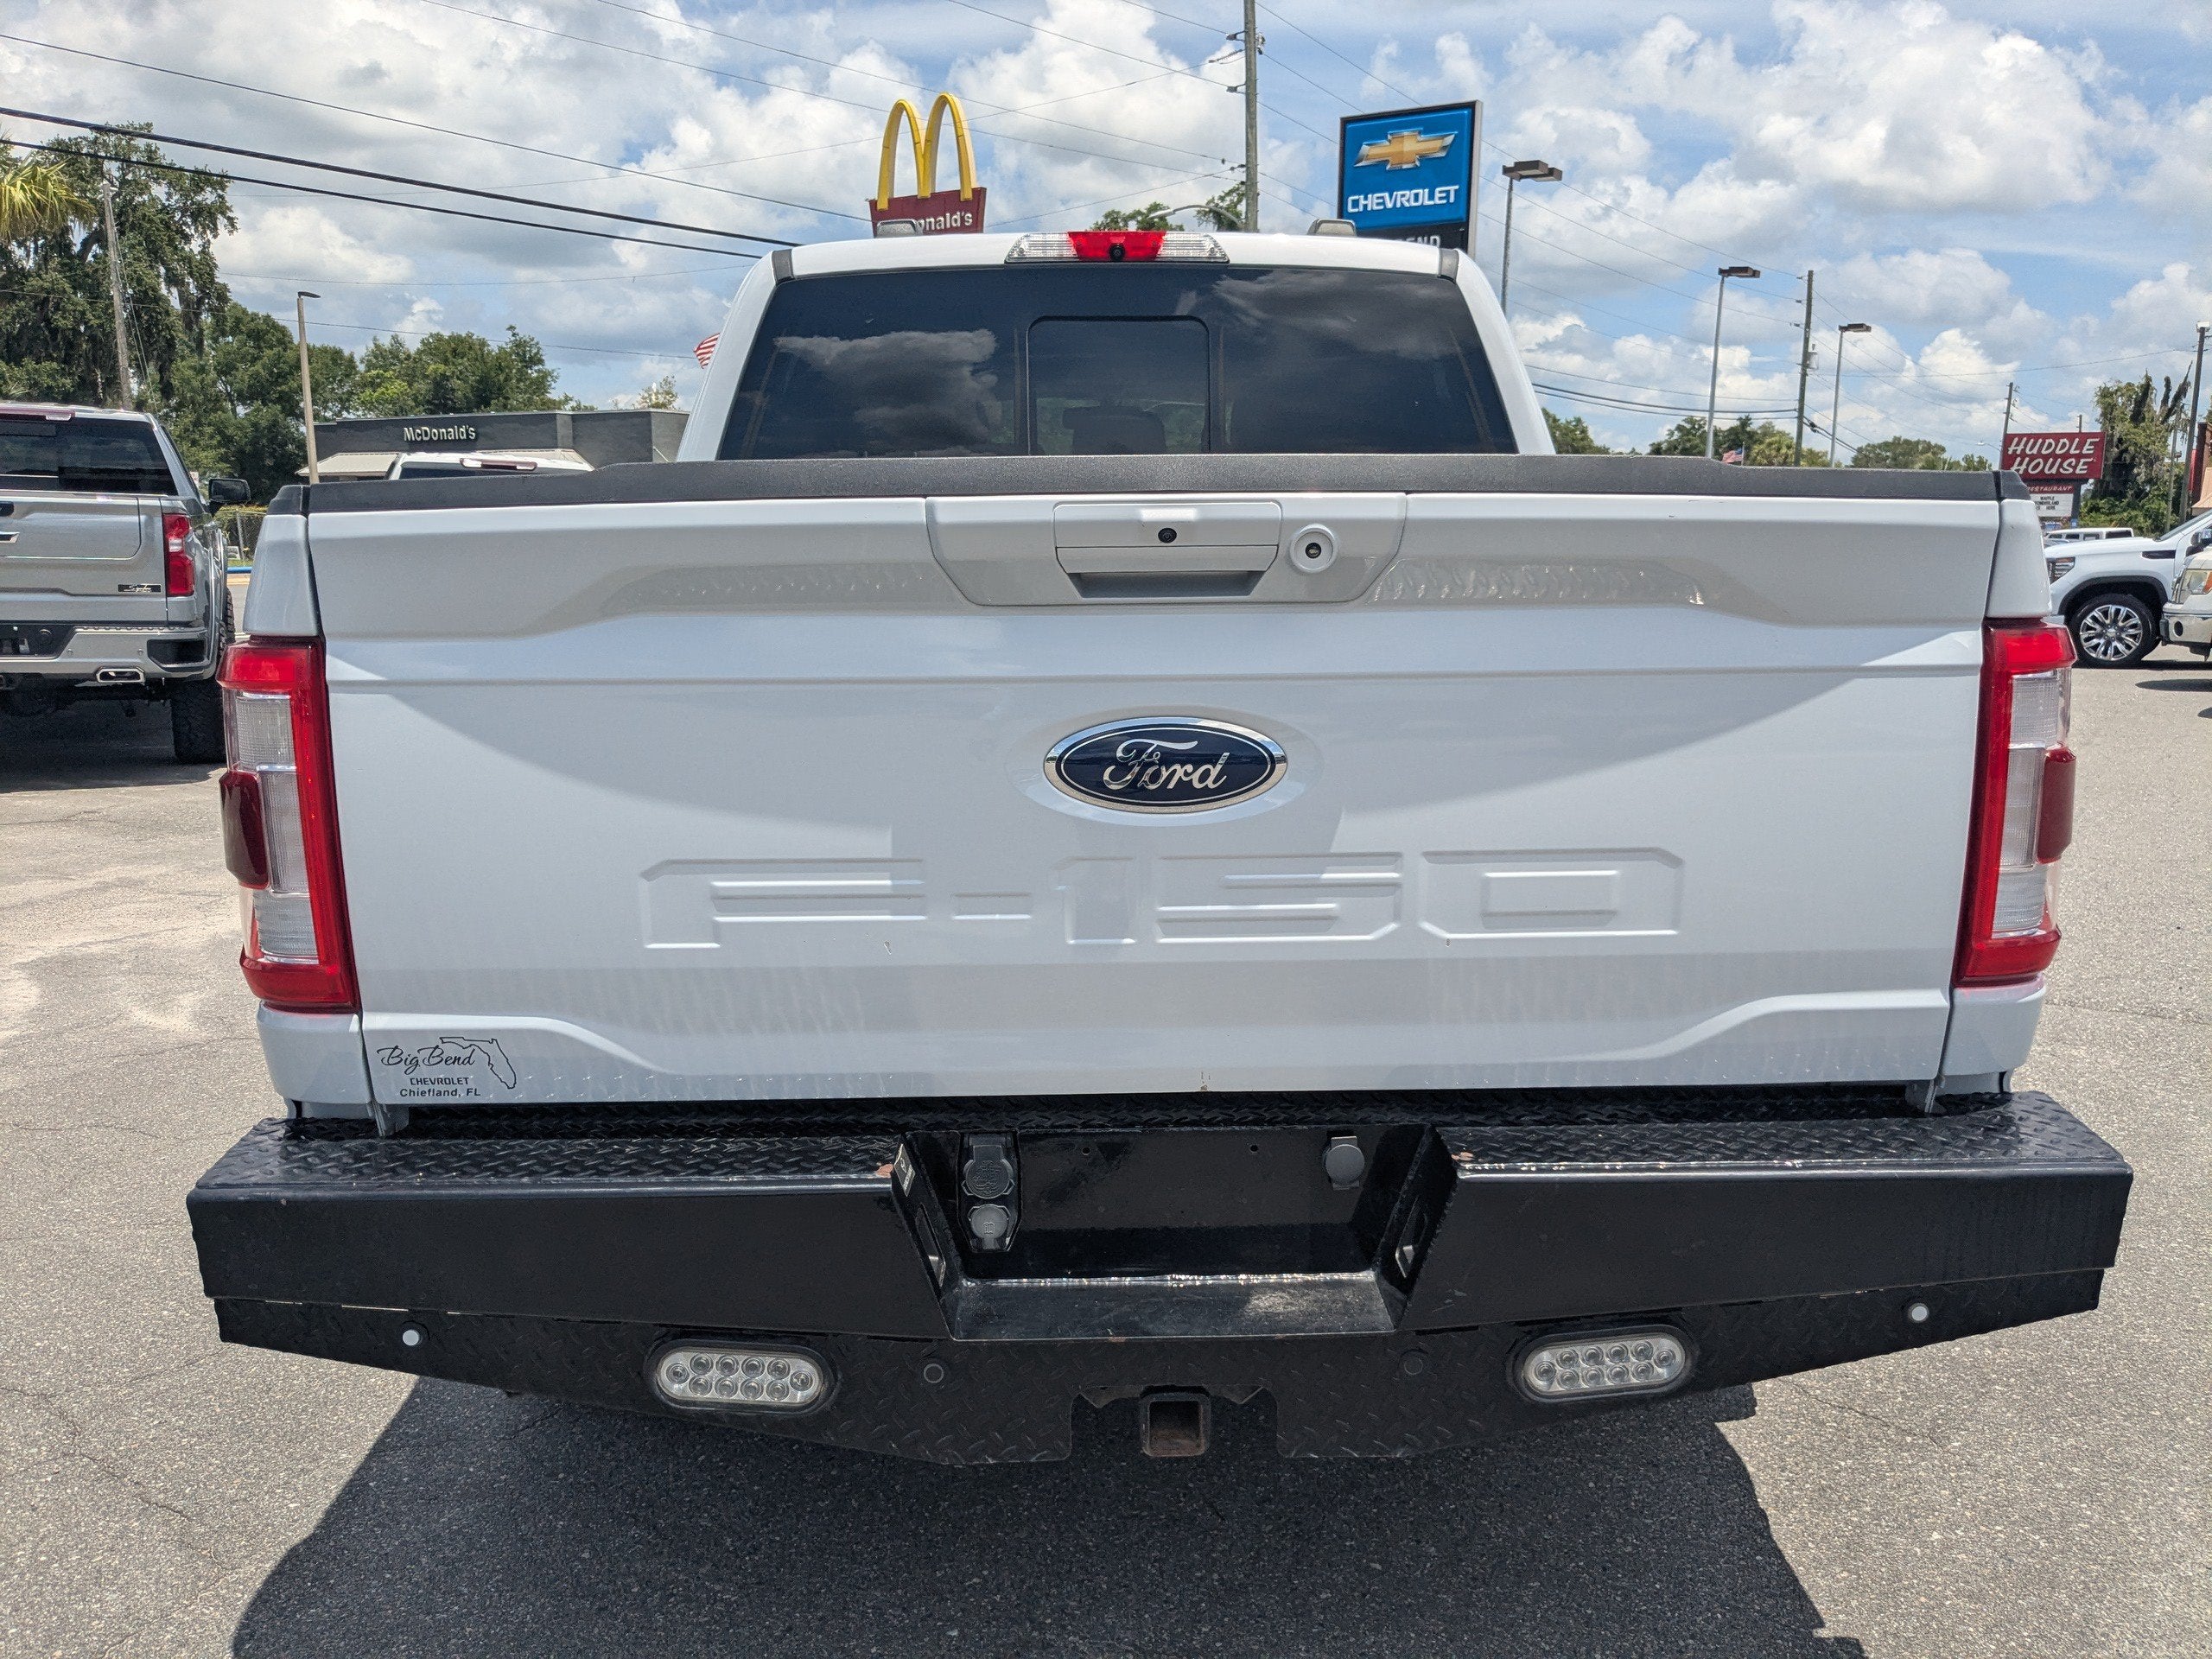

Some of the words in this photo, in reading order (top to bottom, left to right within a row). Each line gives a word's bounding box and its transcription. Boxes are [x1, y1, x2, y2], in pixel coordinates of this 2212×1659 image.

[1347, 185, 1460, 213] CHEVROLET
[916, 211, 973, 232] onald's
[404, 424, 476, 442] McDonald's
[2007, 436, 2101, 455] HUDDLE
[2010, 456, 2094, 474] HOUSE
[1103, 738, 1230, 790] Ford
[639, 849, 1684, 949] F-150
[376, 1045, 421, 1076] Big
[417, 1045, 476, 1066] Bend
[410, 1077, 470, 1086] CHEVROLET
[399, 1087, 461, 1098] Chiefland,
[466, 1087, 481, 1096] FL
